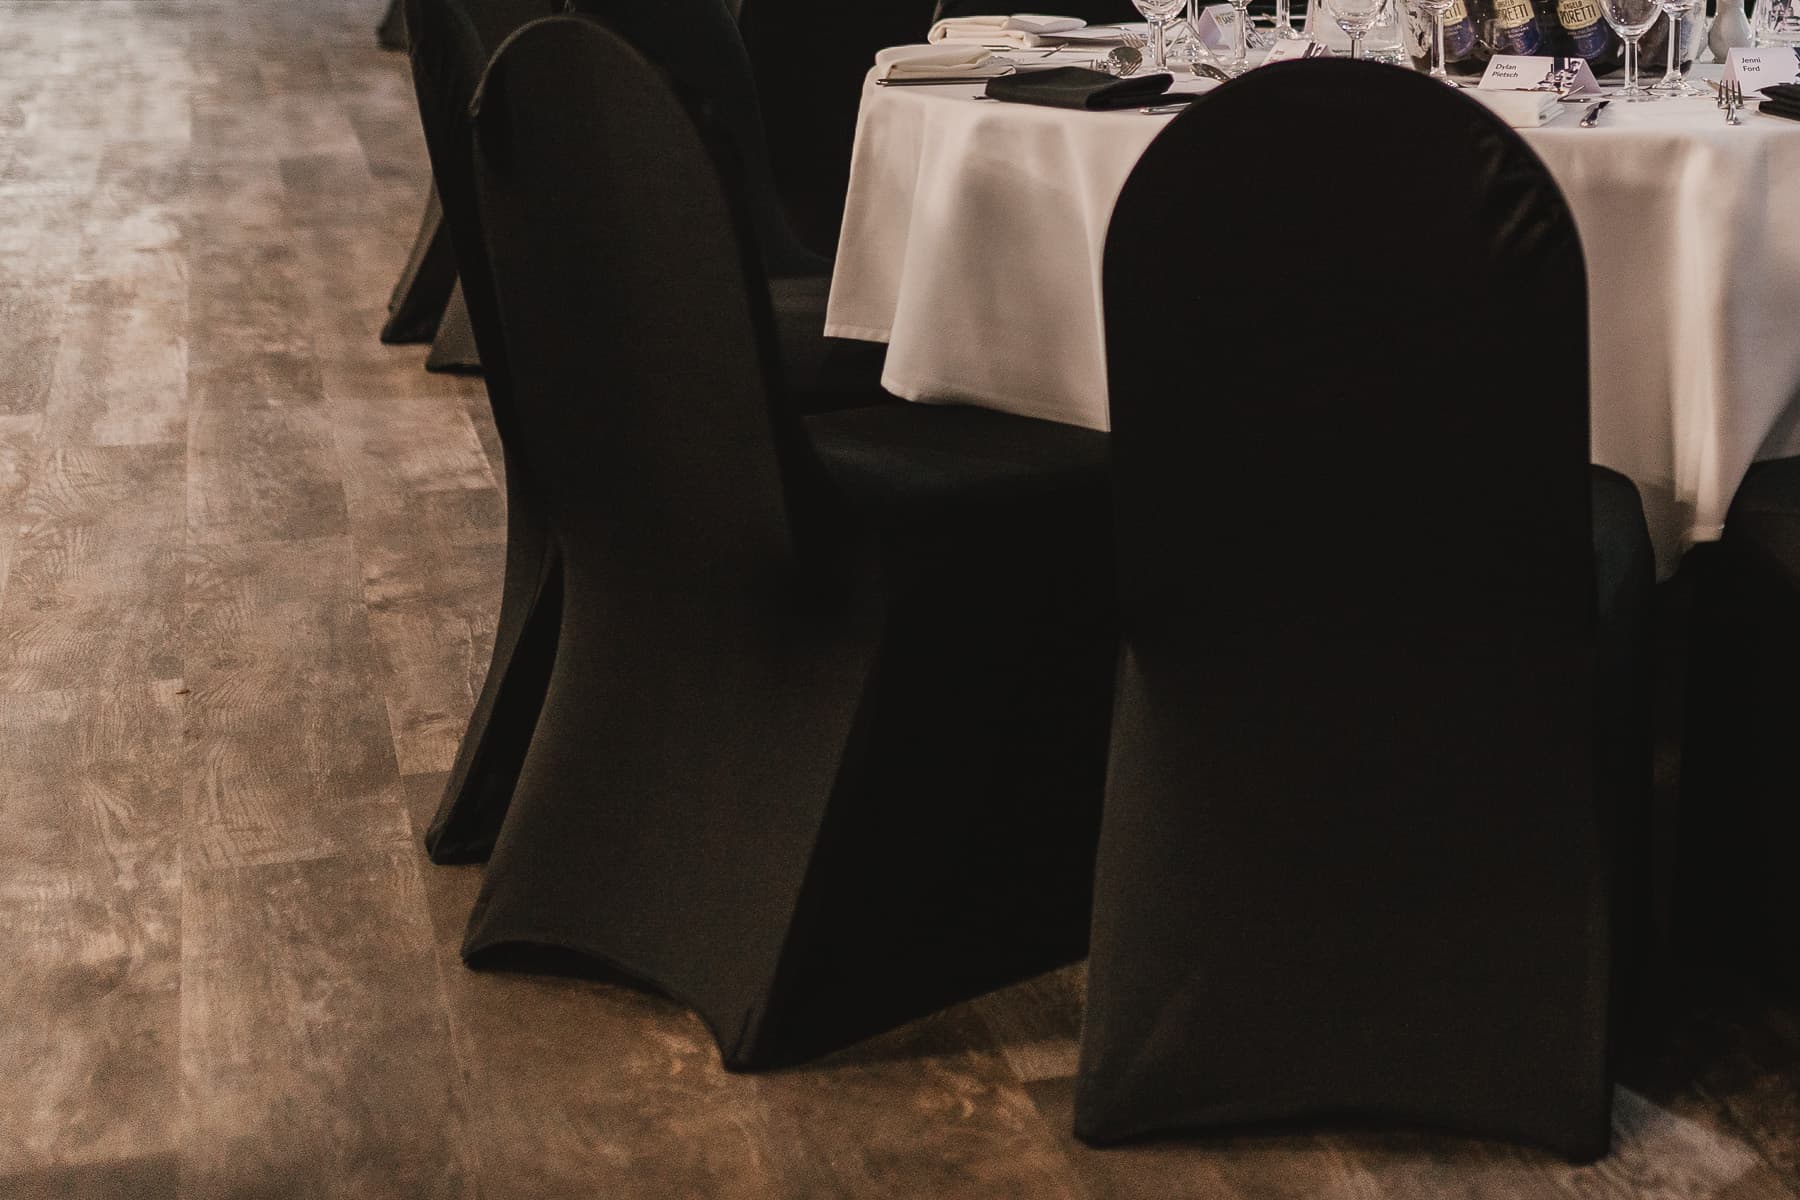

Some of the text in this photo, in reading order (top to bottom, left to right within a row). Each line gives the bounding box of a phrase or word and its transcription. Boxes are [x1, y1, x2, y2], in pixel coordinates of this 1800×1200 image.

[1560, 4, 1597, 25] PORETTI
[1742, 56, 1761, 64] Jenni
[1495, 63, 1517, 71] Dylan
[1491, 71, 1519, 79] Pietsch
